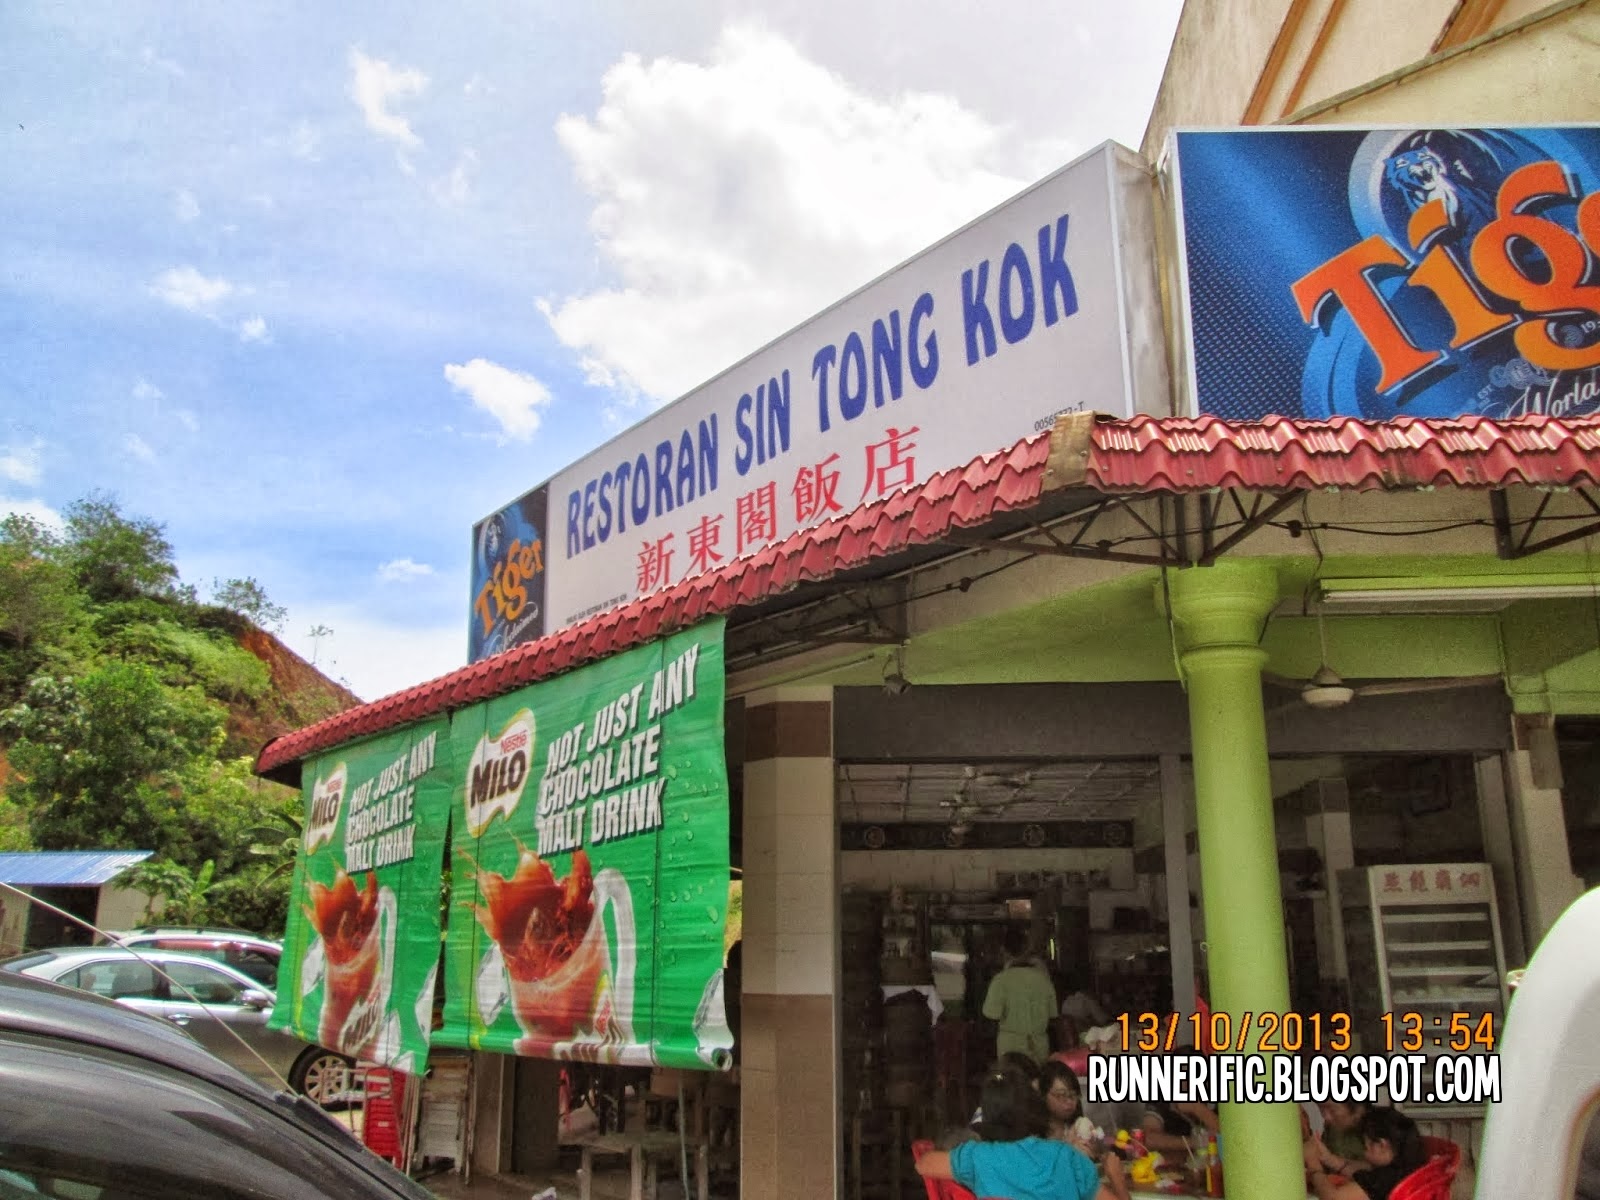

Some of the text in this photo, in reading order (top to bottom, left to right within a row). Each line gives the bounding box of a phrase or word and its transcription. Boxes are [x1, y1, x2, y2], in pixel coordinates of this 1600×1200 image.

[1290, 160, 1600, 395] Tig
[566, 213, 1080, 560] RESTORAN SIN TONG KOK
[635, 425, 921, 593] 新東閣飯店
[473, 538, 545, 640] Tiger
[546, 643, 700, 776] NOT JUST ANY
[346, 784, 416, 845] CHOCOLATE
[350, 731, 437, 815] NOT JUST ANY
[470, 750, 527, 809] MILO
[536, 777, 668, 857] MALT DRINK
[538, 724, 662, 817] CHOCOLATE
[345, 823, 417, 873] MALT DRINK
